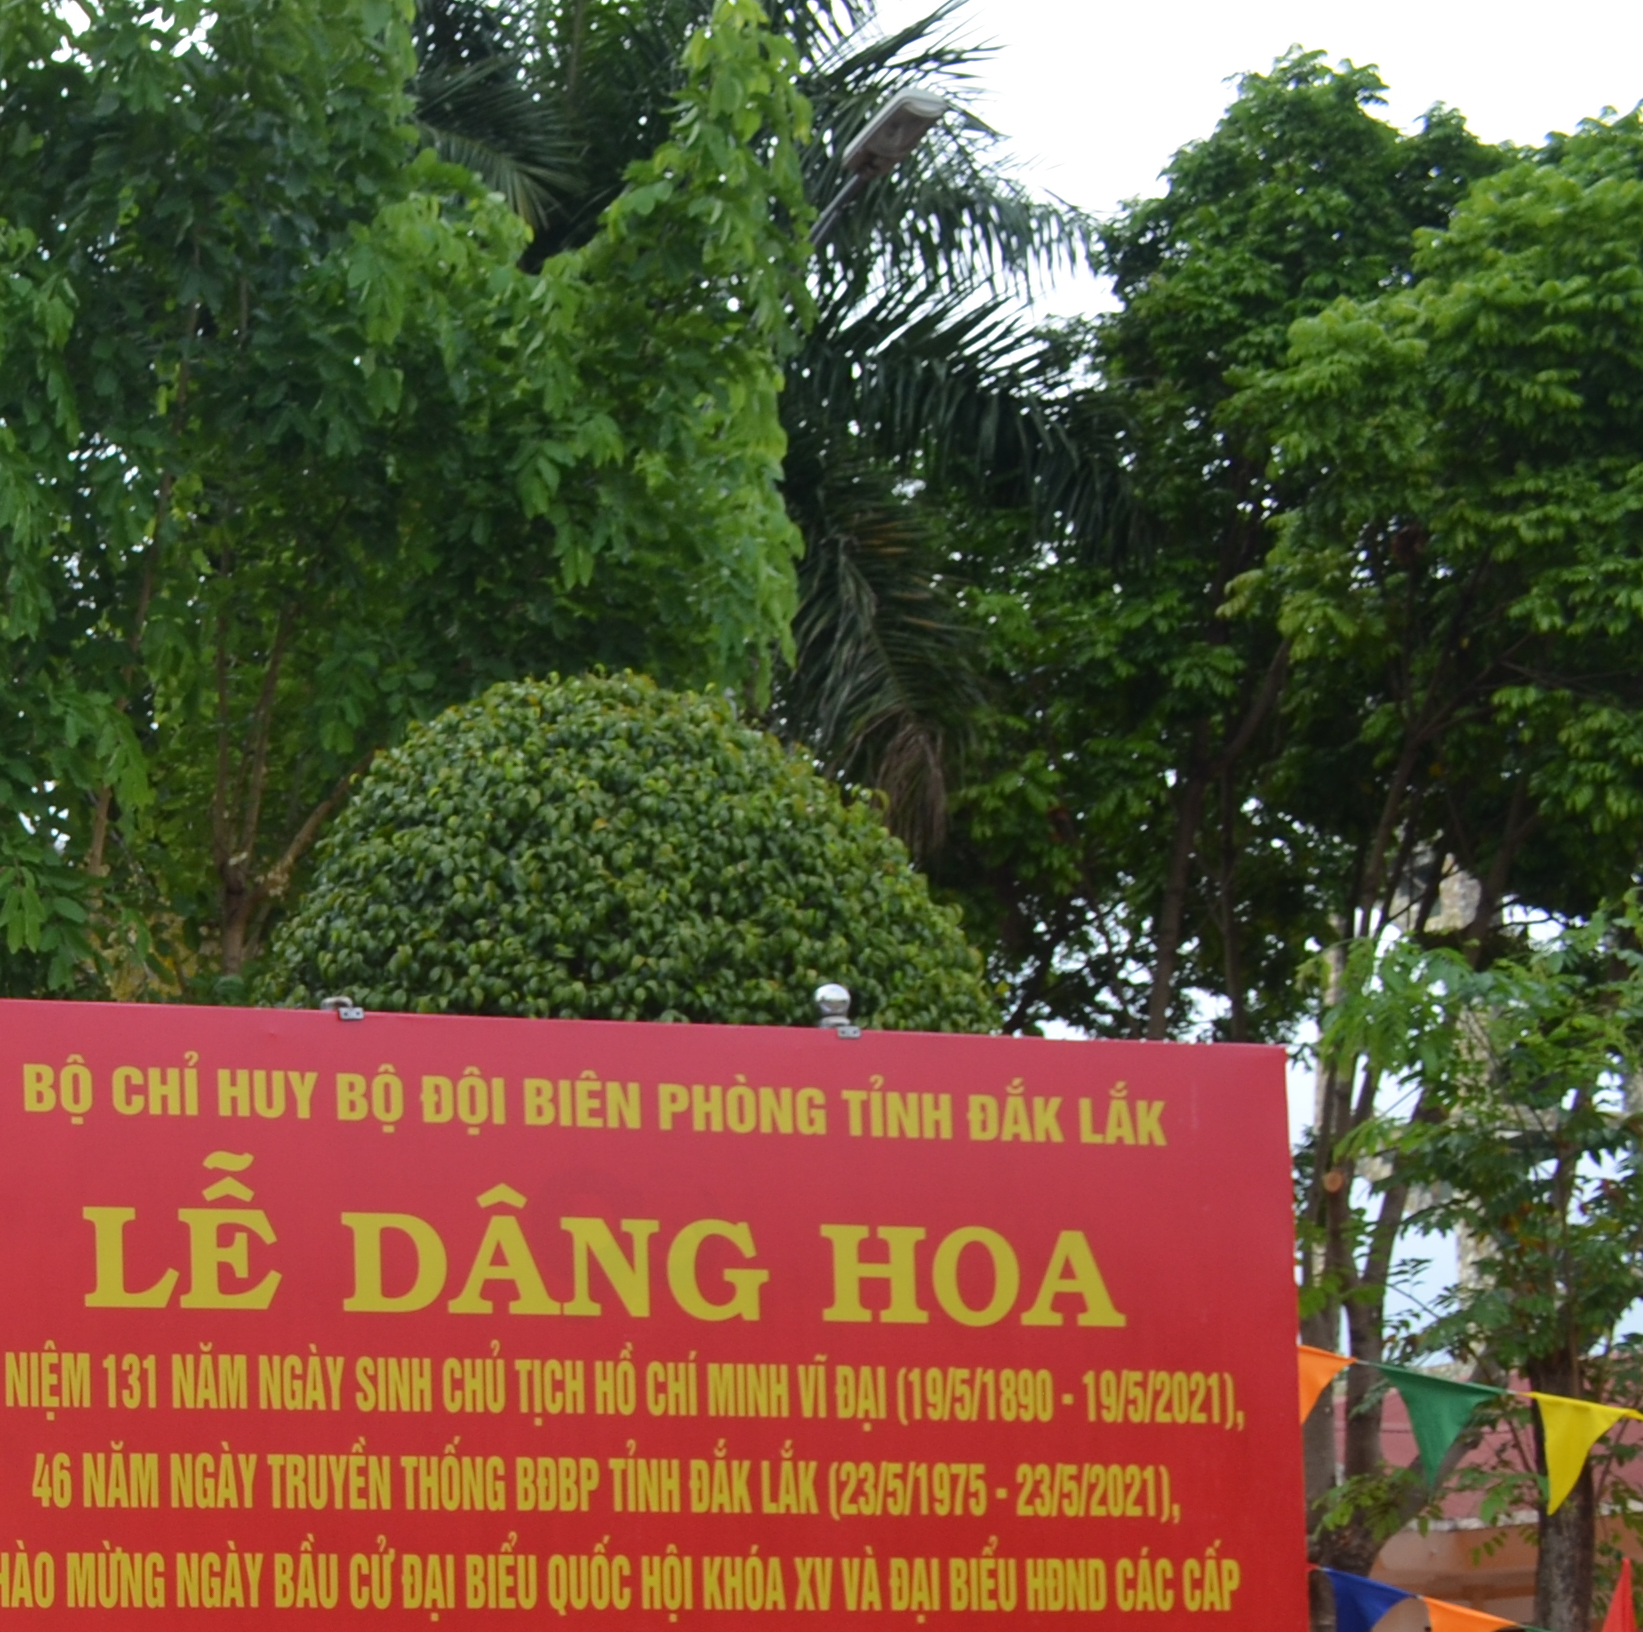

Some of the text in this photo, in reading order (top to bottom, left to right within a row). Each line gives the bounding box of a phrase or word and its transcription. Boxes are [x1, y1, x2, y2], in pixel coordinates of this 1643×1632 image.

[23, 1052, 1166, 1146] BỘ CHỈ HUY BỘ ĐỘI BIÊN PHÒNG TỈNH ĐẮK LẮK
[82, 1151, 1127, 1328] LỄ DÂNG HOA
[5, 1340, 92, 1421] NIỆM
[102, 1353, 157, 1410] 131
[171, 1343, 248, 1410] NĂM
[258, 1345, 345, 1411] NGÀY
[355, 1356, 433, 1413] SINH
[442, 1340, 506, 1414] CHỦ
[514, 1358, 586, 1426] TỊCH
[594, 1345, 637, 1416] HỒ
[646, 1352, 698, 1417] CHÍ
[707, 1362, 790, 1418] MINH
[797, 1354, 828, 1419] VĨ
[835, 1364, 887, 1432] ĐẠI
[896, 1367, 1054, 1424] (19/5/1890
[1061, 1393, 1074, 1405] -
[1083, 1369, 1245, 1428] 19/5/2021),
[31, 1437, 1181, 1522] 46 NĂM NGÀY TRUYỀN THỐNG BĐBP TỈNH ĐẮK LẮK (23/5/1975 - 23/5/2021),
[66, 1540, 166, 1609] MỪNG
[175, 1540, 264, 1609] NGÀY
[273, 1534, 339, 1610] BẦU
[349, 1535, 396, 1610] CỬ
[401, 1553, 456, 1622] ĐẠI
[465, 1531, 538, 1610] BIỂU
[547, 1536, 632, 1616] QUỐC
[640, 1543, 694, 1623] HỘI
[702, 1545, 786, 1612] KHÓA
[794, 1556, 833, 1611] XV
[841, 1546, 882, 1612] VÀ
[888, 1557, 941, 1624] ĐẠI
[949, 1535, 1018, 1612] BIỂU
[1025, 1558, 1107, 1612] HĐND
[1115, 1547, 1175, 1612] CÁC
[1182, 1540, 1241, 1612] CẤP
